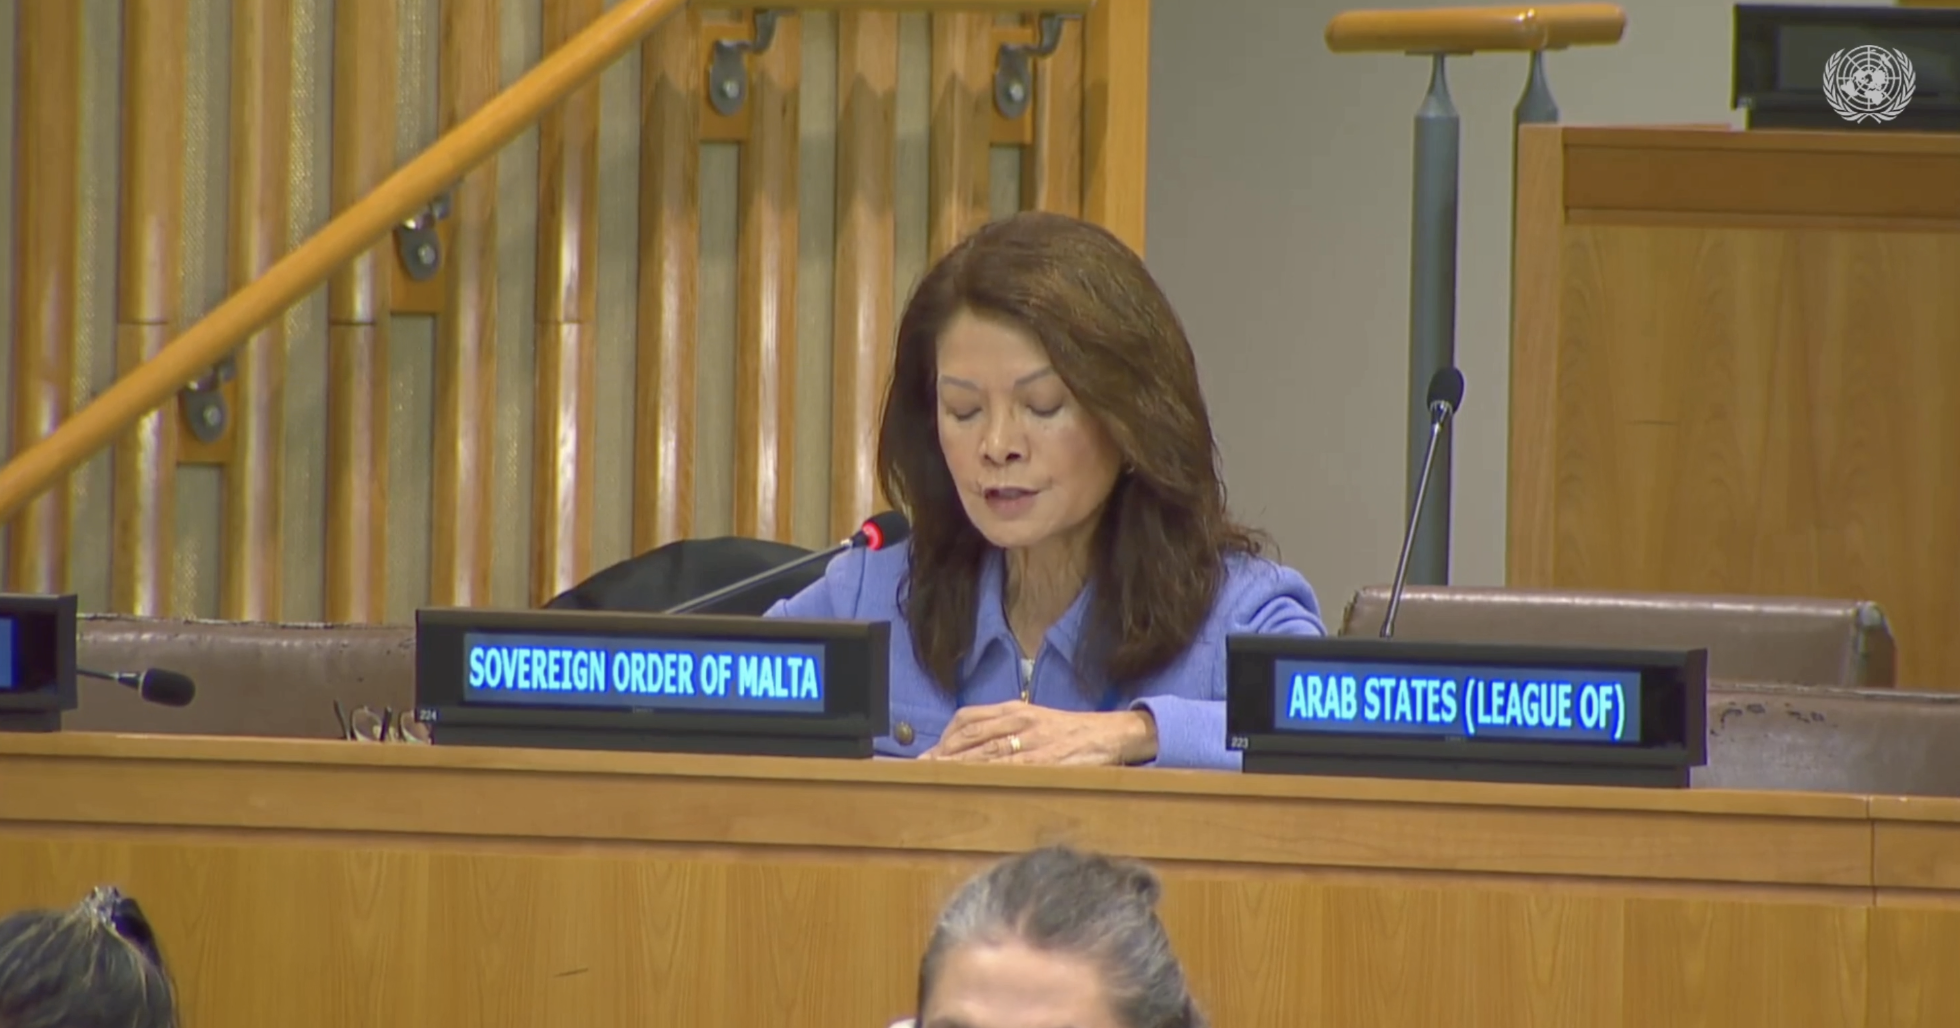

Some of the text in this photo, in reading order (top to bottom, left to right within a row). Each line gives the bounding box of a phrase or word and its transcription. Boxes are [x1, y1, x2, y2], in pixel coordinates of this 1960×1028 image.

[468, 647, 820, 699] SOVEREIGN ORDER OF MALTA
[419, 709, 438, 721] 224
[1288, 674, 1626, 740] ARAB STATES (LEAGUE OF)
[1230, 736, 1250, 749] 223
